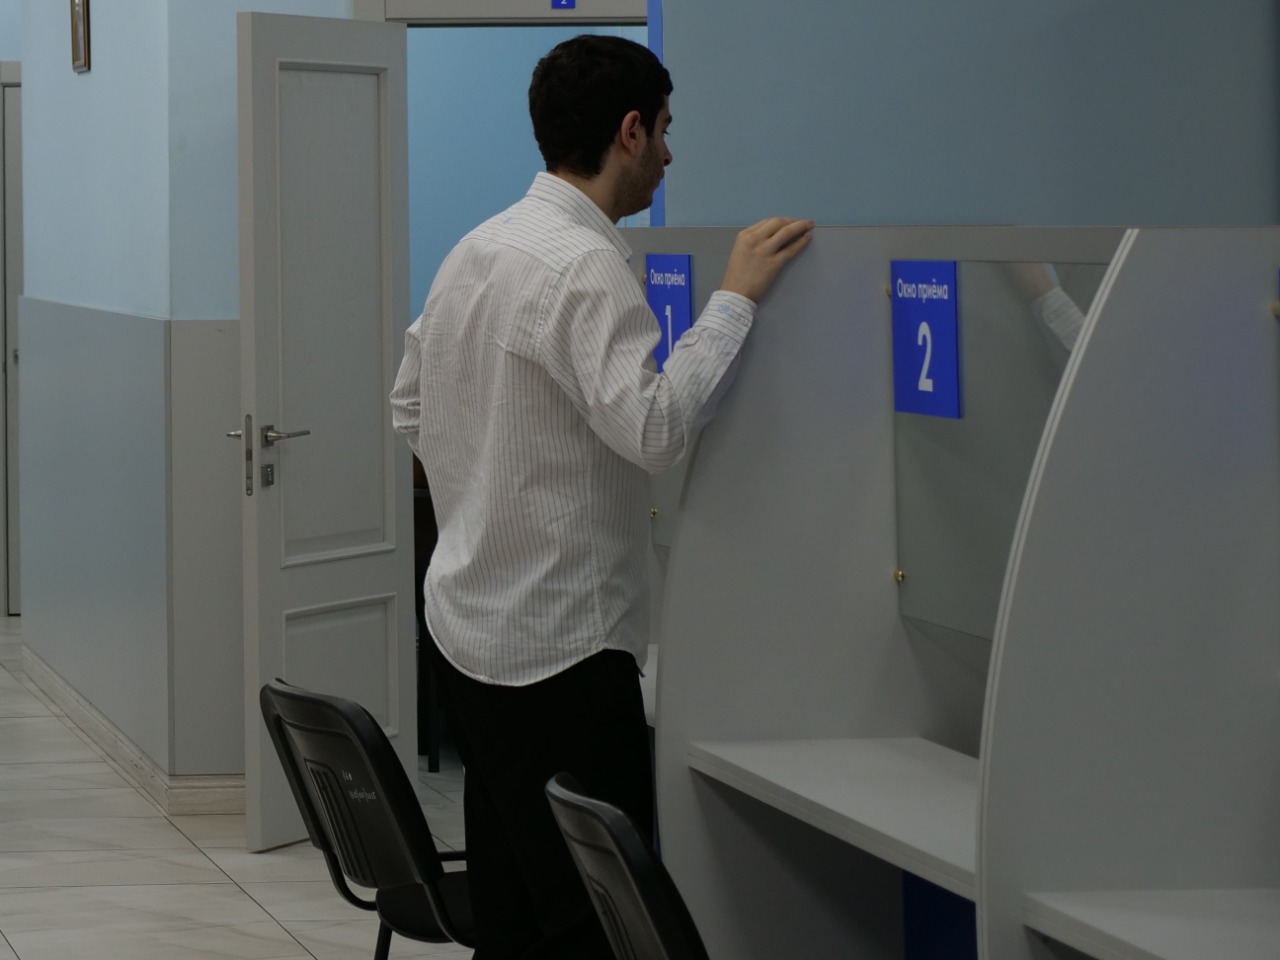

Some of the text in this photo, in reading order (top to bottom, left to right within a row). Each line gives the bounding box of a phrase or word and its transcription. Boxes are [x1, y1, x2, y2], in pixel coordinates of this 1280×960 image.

[650, 268, 664, 285] Окно
[896, 277, 949, 304] Окно приёма
[917, 321, 933, 392] 2
